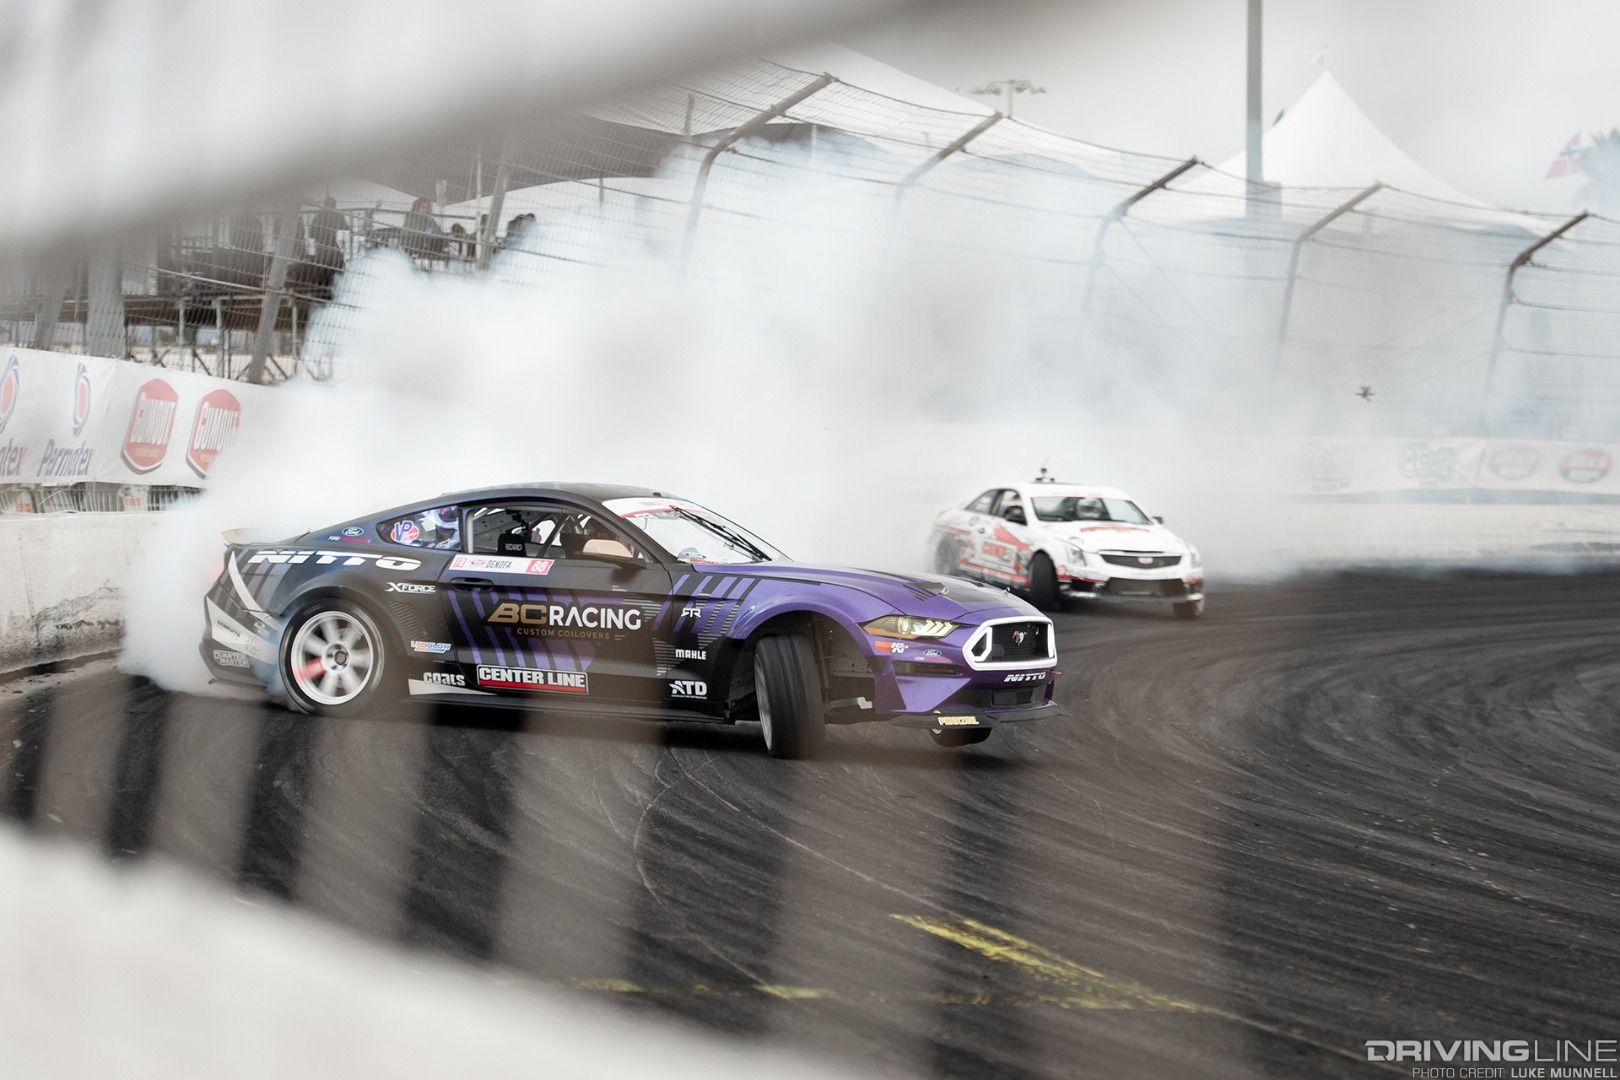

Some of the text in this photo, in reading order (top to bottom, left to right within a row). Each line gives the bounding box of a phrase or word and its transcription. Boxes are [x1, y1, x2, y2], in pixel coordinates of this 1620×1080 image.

[36, 438, 95, 477] Permatex
[394, 520, 413, 541] VP
[247, 550, 422, 571] NITTO
[485, 560, 512, 569] DENOFA
[531, 560, 548, 573] 88
[384, 582, 437, 594] XFORCE
[516, 627, 610, 640] CUSTOM COILOVERS
[675, 648, 707, 660] MAHLE
[479, 666, 586, 688] CENTER LINE
[1003, 672, 1047, 682] NITTO
[669, 680, 708, 696] ATD
